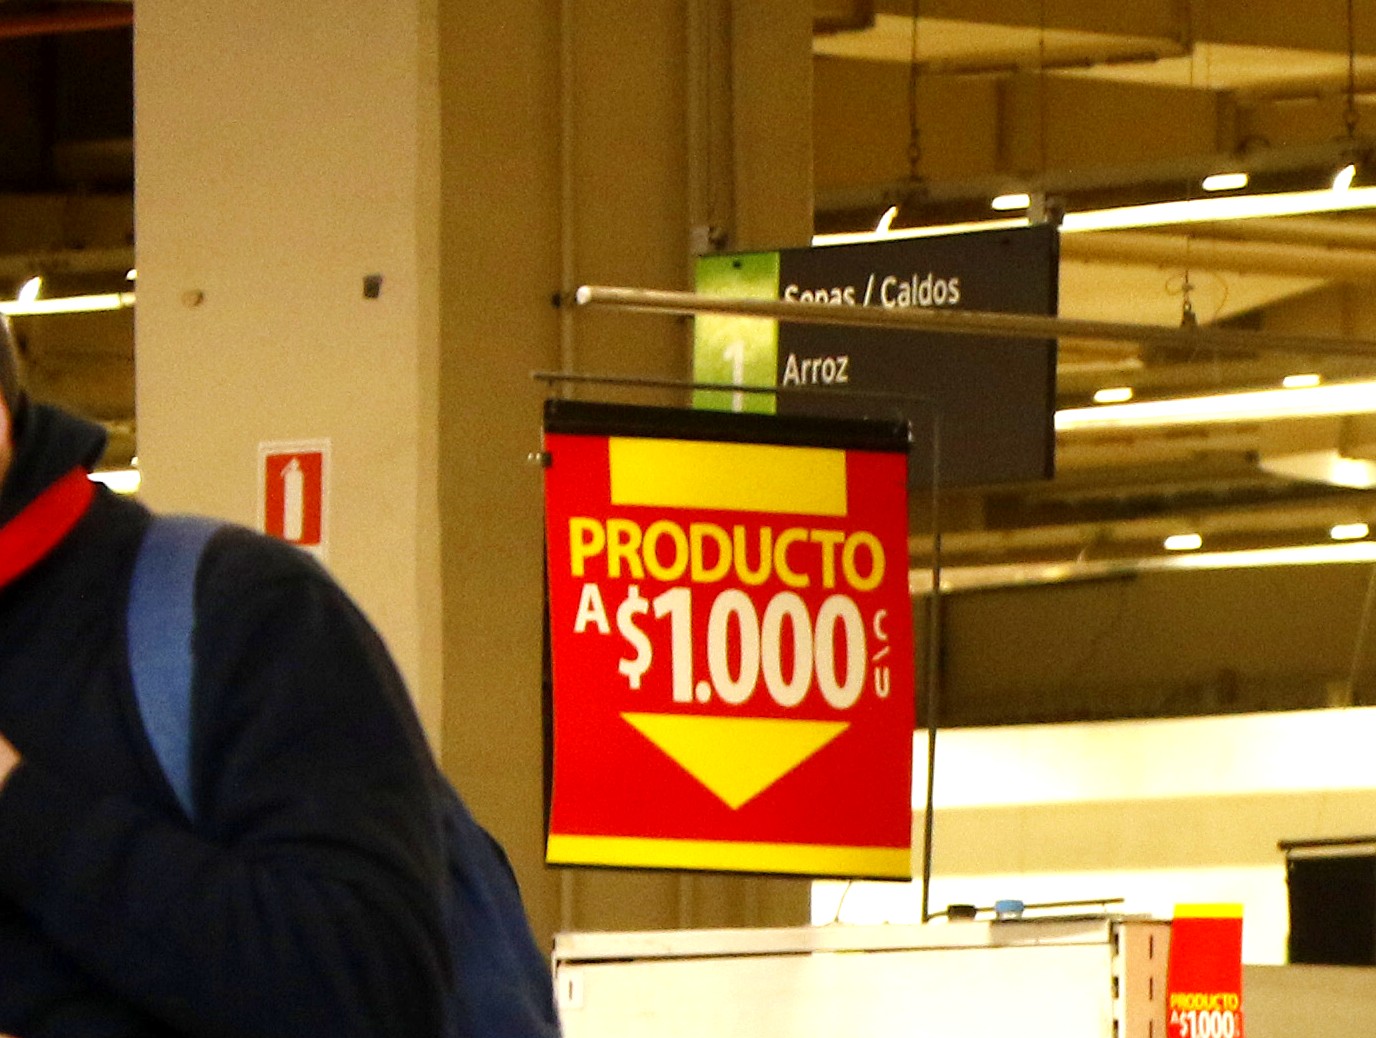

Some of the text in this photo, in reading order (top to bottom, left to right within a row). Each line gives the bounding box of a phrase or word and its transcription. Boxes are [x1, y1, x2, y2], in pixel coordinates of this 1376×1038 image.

[880, 271, 961, 310] Caldos
[722, 341, 745, 413] 1
[782, 352, 850, 387] Arroz
[568, 516, 887, 592] PRODUCTO
[573, 582, 611, 635] A
[615, 583, 868, 711] $1.000
[1169, 991, 1240, 1011] PRODUCTO
